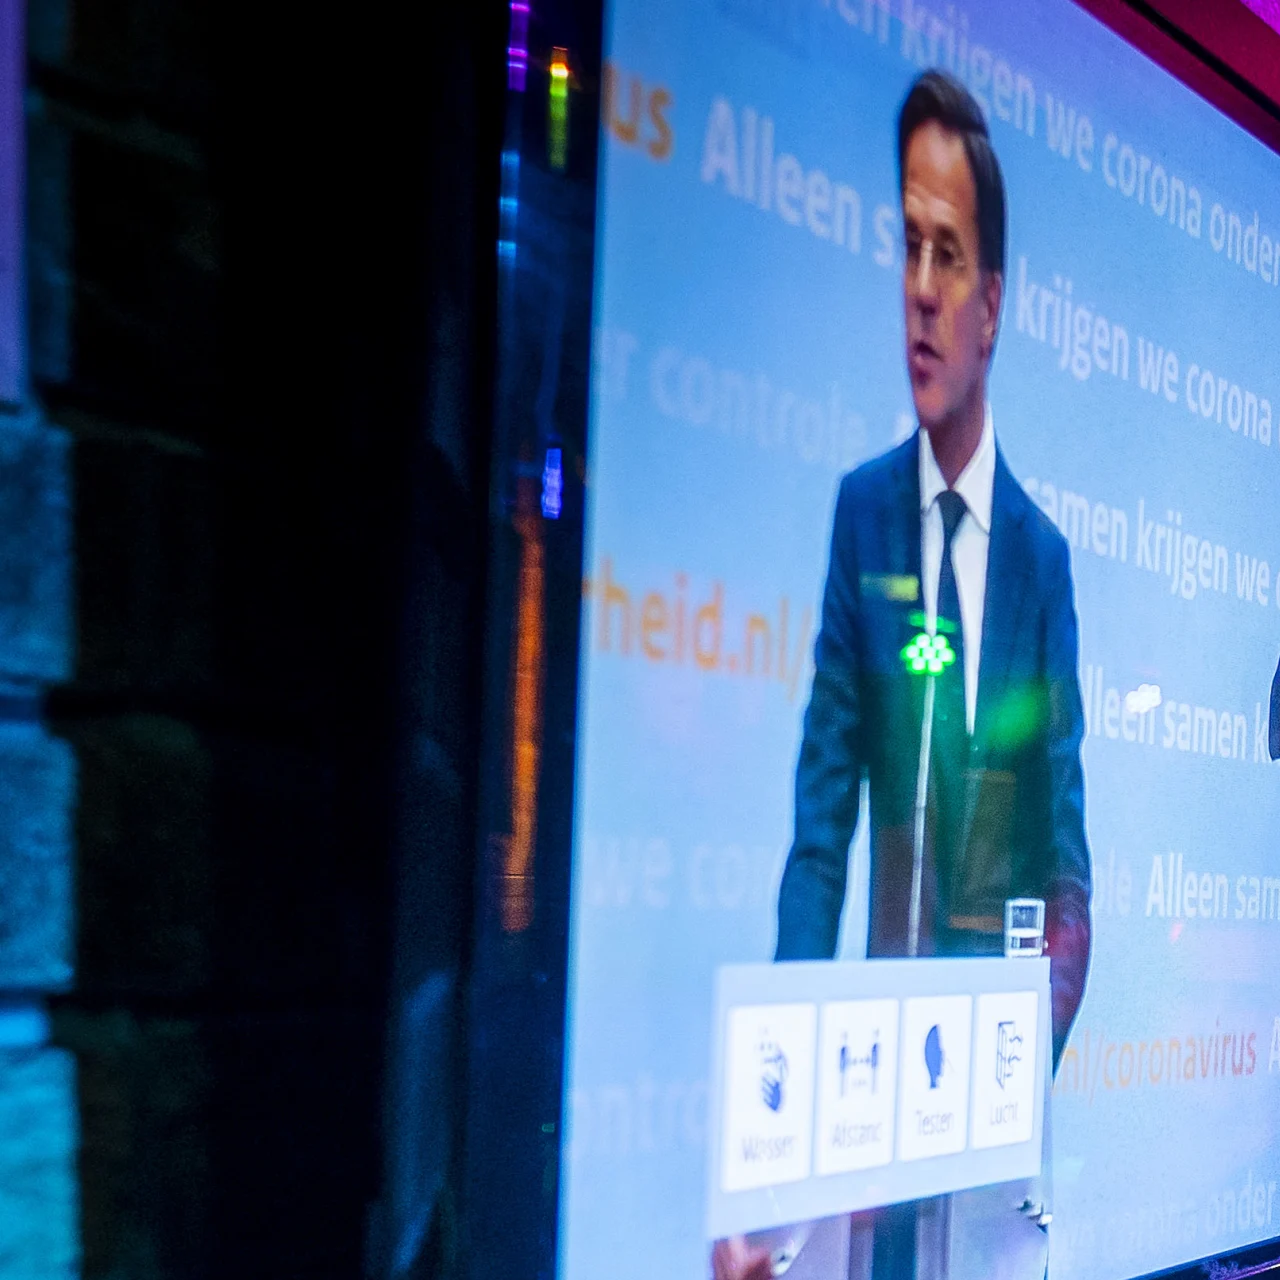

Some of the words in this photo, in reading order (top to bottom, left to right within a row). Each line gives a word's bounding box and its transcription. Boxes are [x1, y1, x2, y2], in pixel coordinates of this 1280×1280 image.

[702, 96, 862, 255] Alleen
[1047, 92, 1094, 173] we
[1103, 131, 1201, 240] corona
[1015, 254, 1130, 382] krijgen
[1138, 335, 1179, 403] we
[1186, 364, 1272, 447] corona
[1135, 497, 1228, 601] krijgen
[1235, 552, 1269, 605] we
[1083, 664, 1156, 746] lleen
[1162, 700, 1248, 761] samen
[1145, 852, 1229, 919] Alleen
